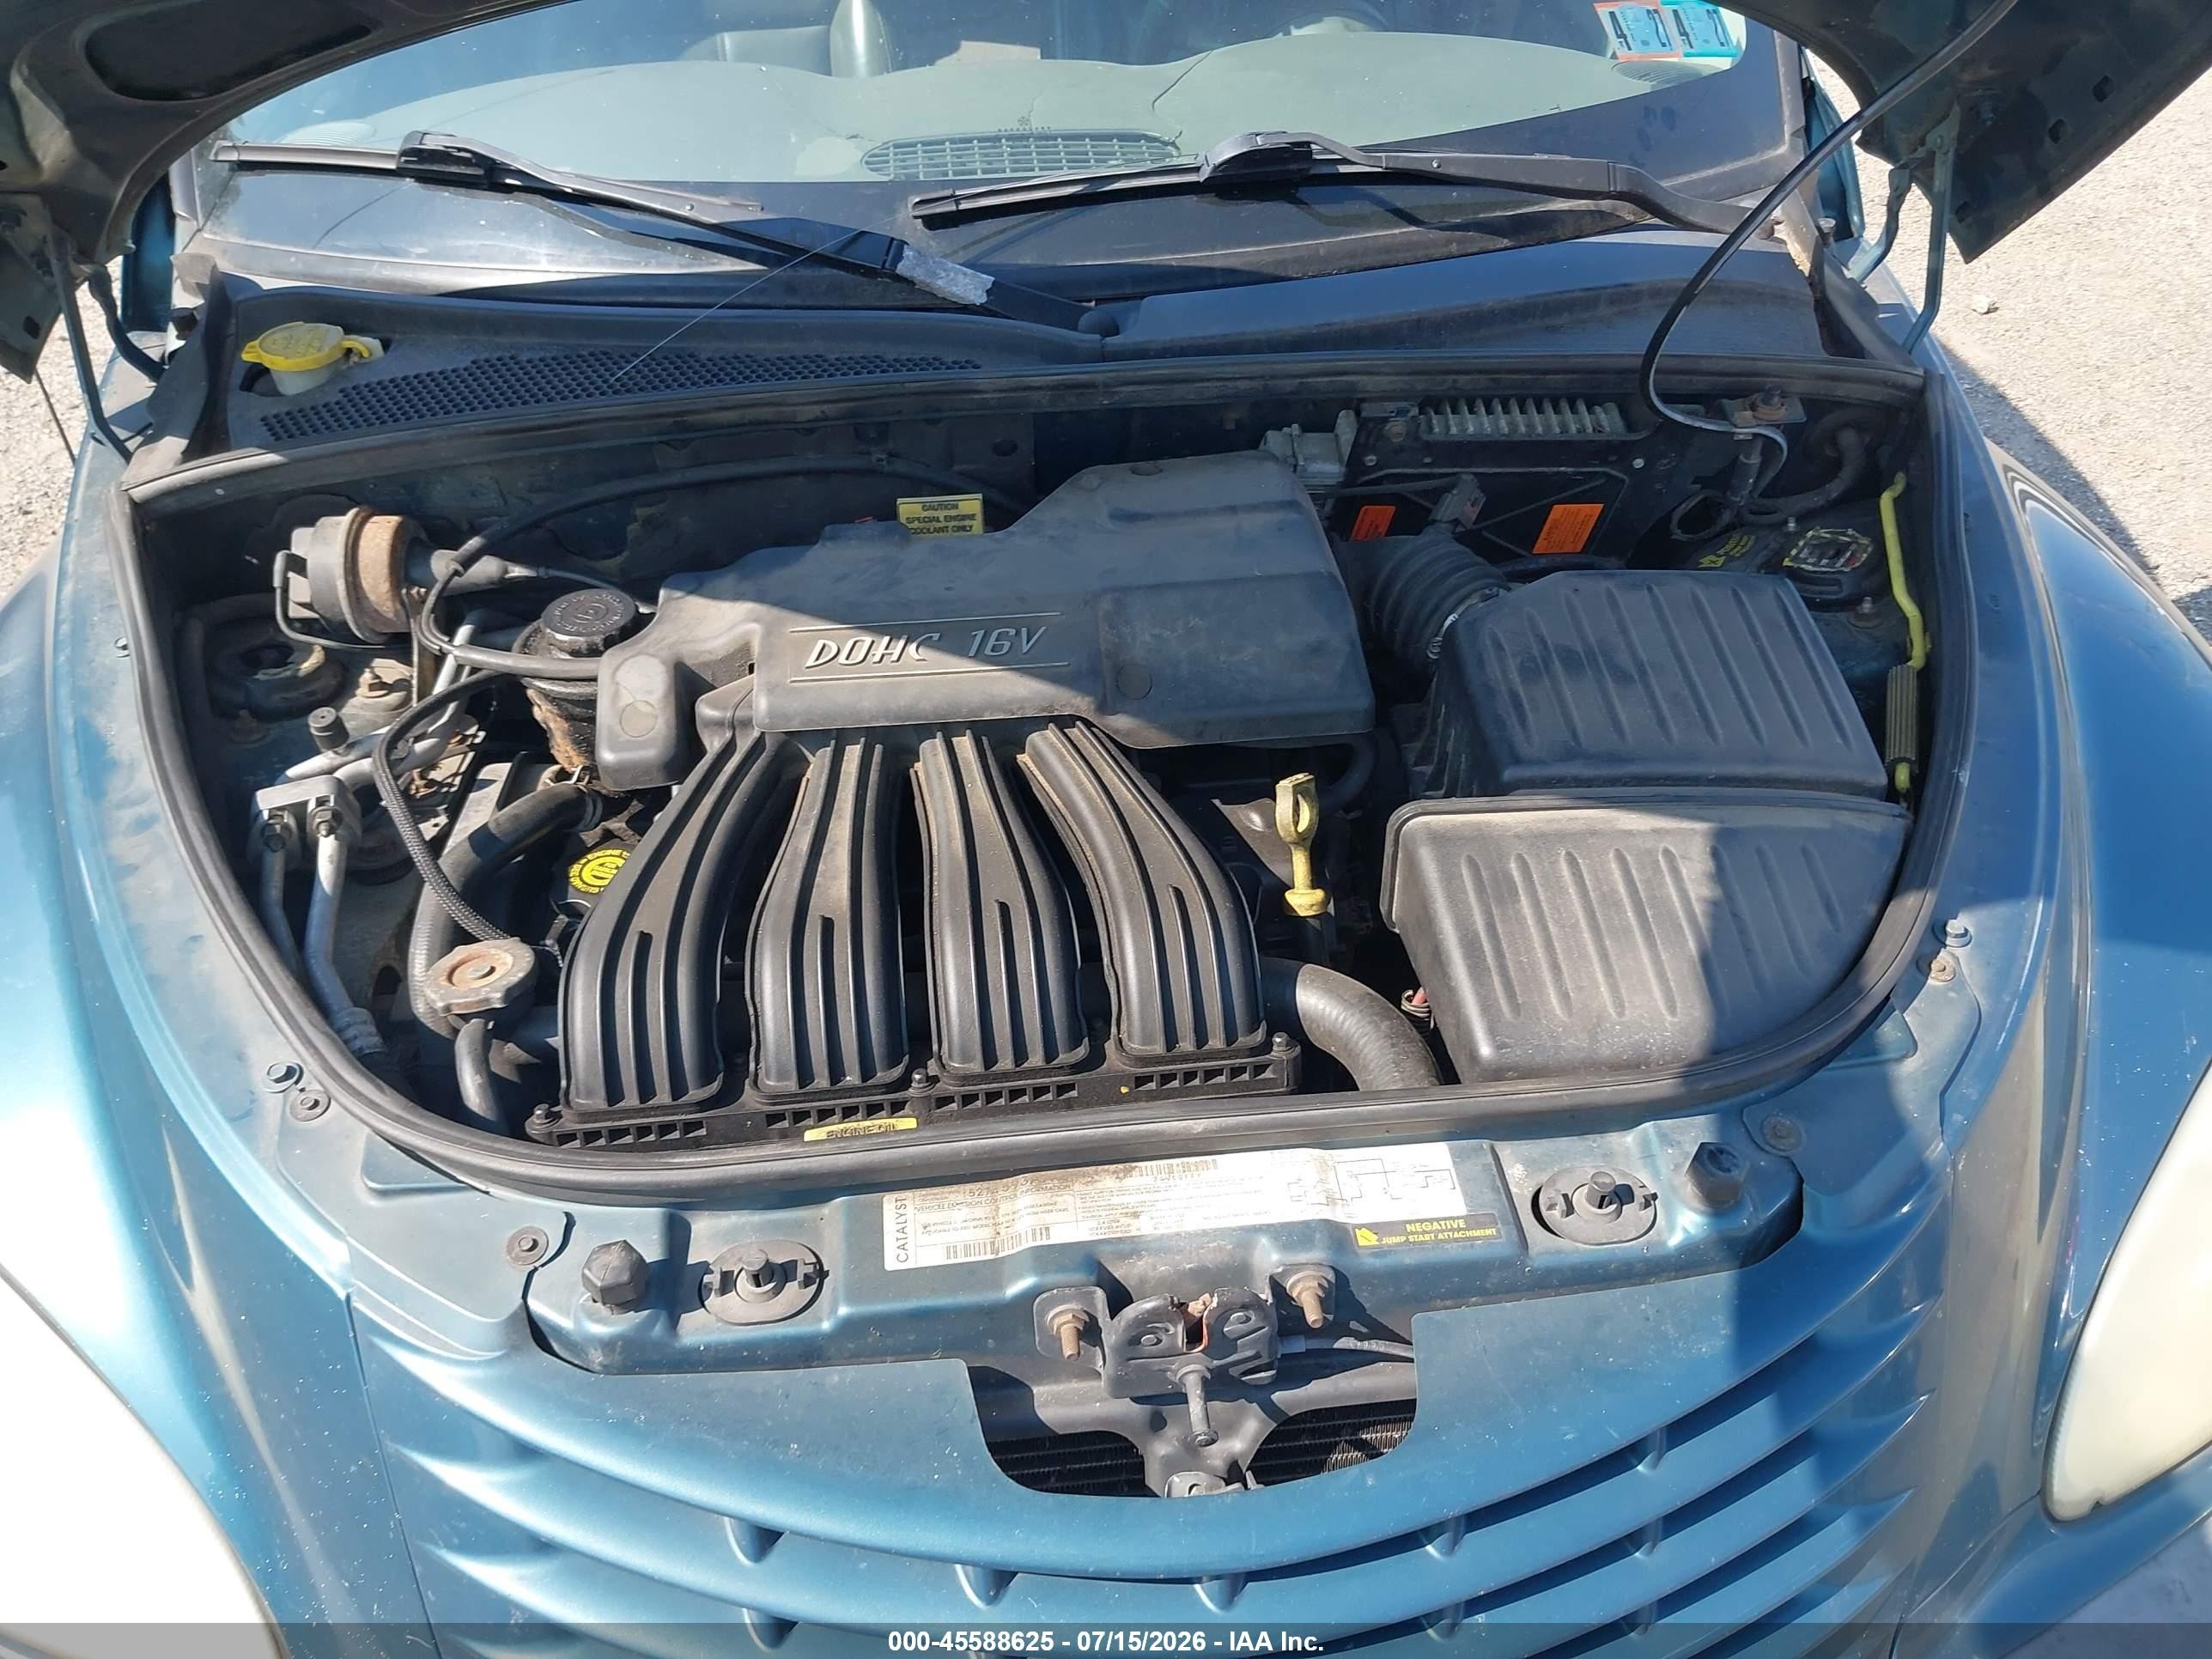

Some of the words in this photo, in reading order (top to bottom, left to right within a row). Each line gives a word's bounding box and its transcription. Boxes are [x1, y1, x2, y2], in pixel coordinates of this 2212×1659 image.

[921, 502, 959, 512] CAUTION
[905, 515, 942, 525] SPECIAL
[944, 513, 977, 523] ENGINE
[951, 524, 974, 533] ONLY
[804, 632, 941, 670] DOHC
[967, 625, 1047, 658] 16V
[895, 1195, 908, 1264] CATALYST
[1405, 1218, 1467, 1233] NEGATIVE
[1380, 1235, 1407, 1245] JUMP
[1407, 1231, 1437, 1243] START
[1437, 1227, 1498, 1241] ATTACHMENT
